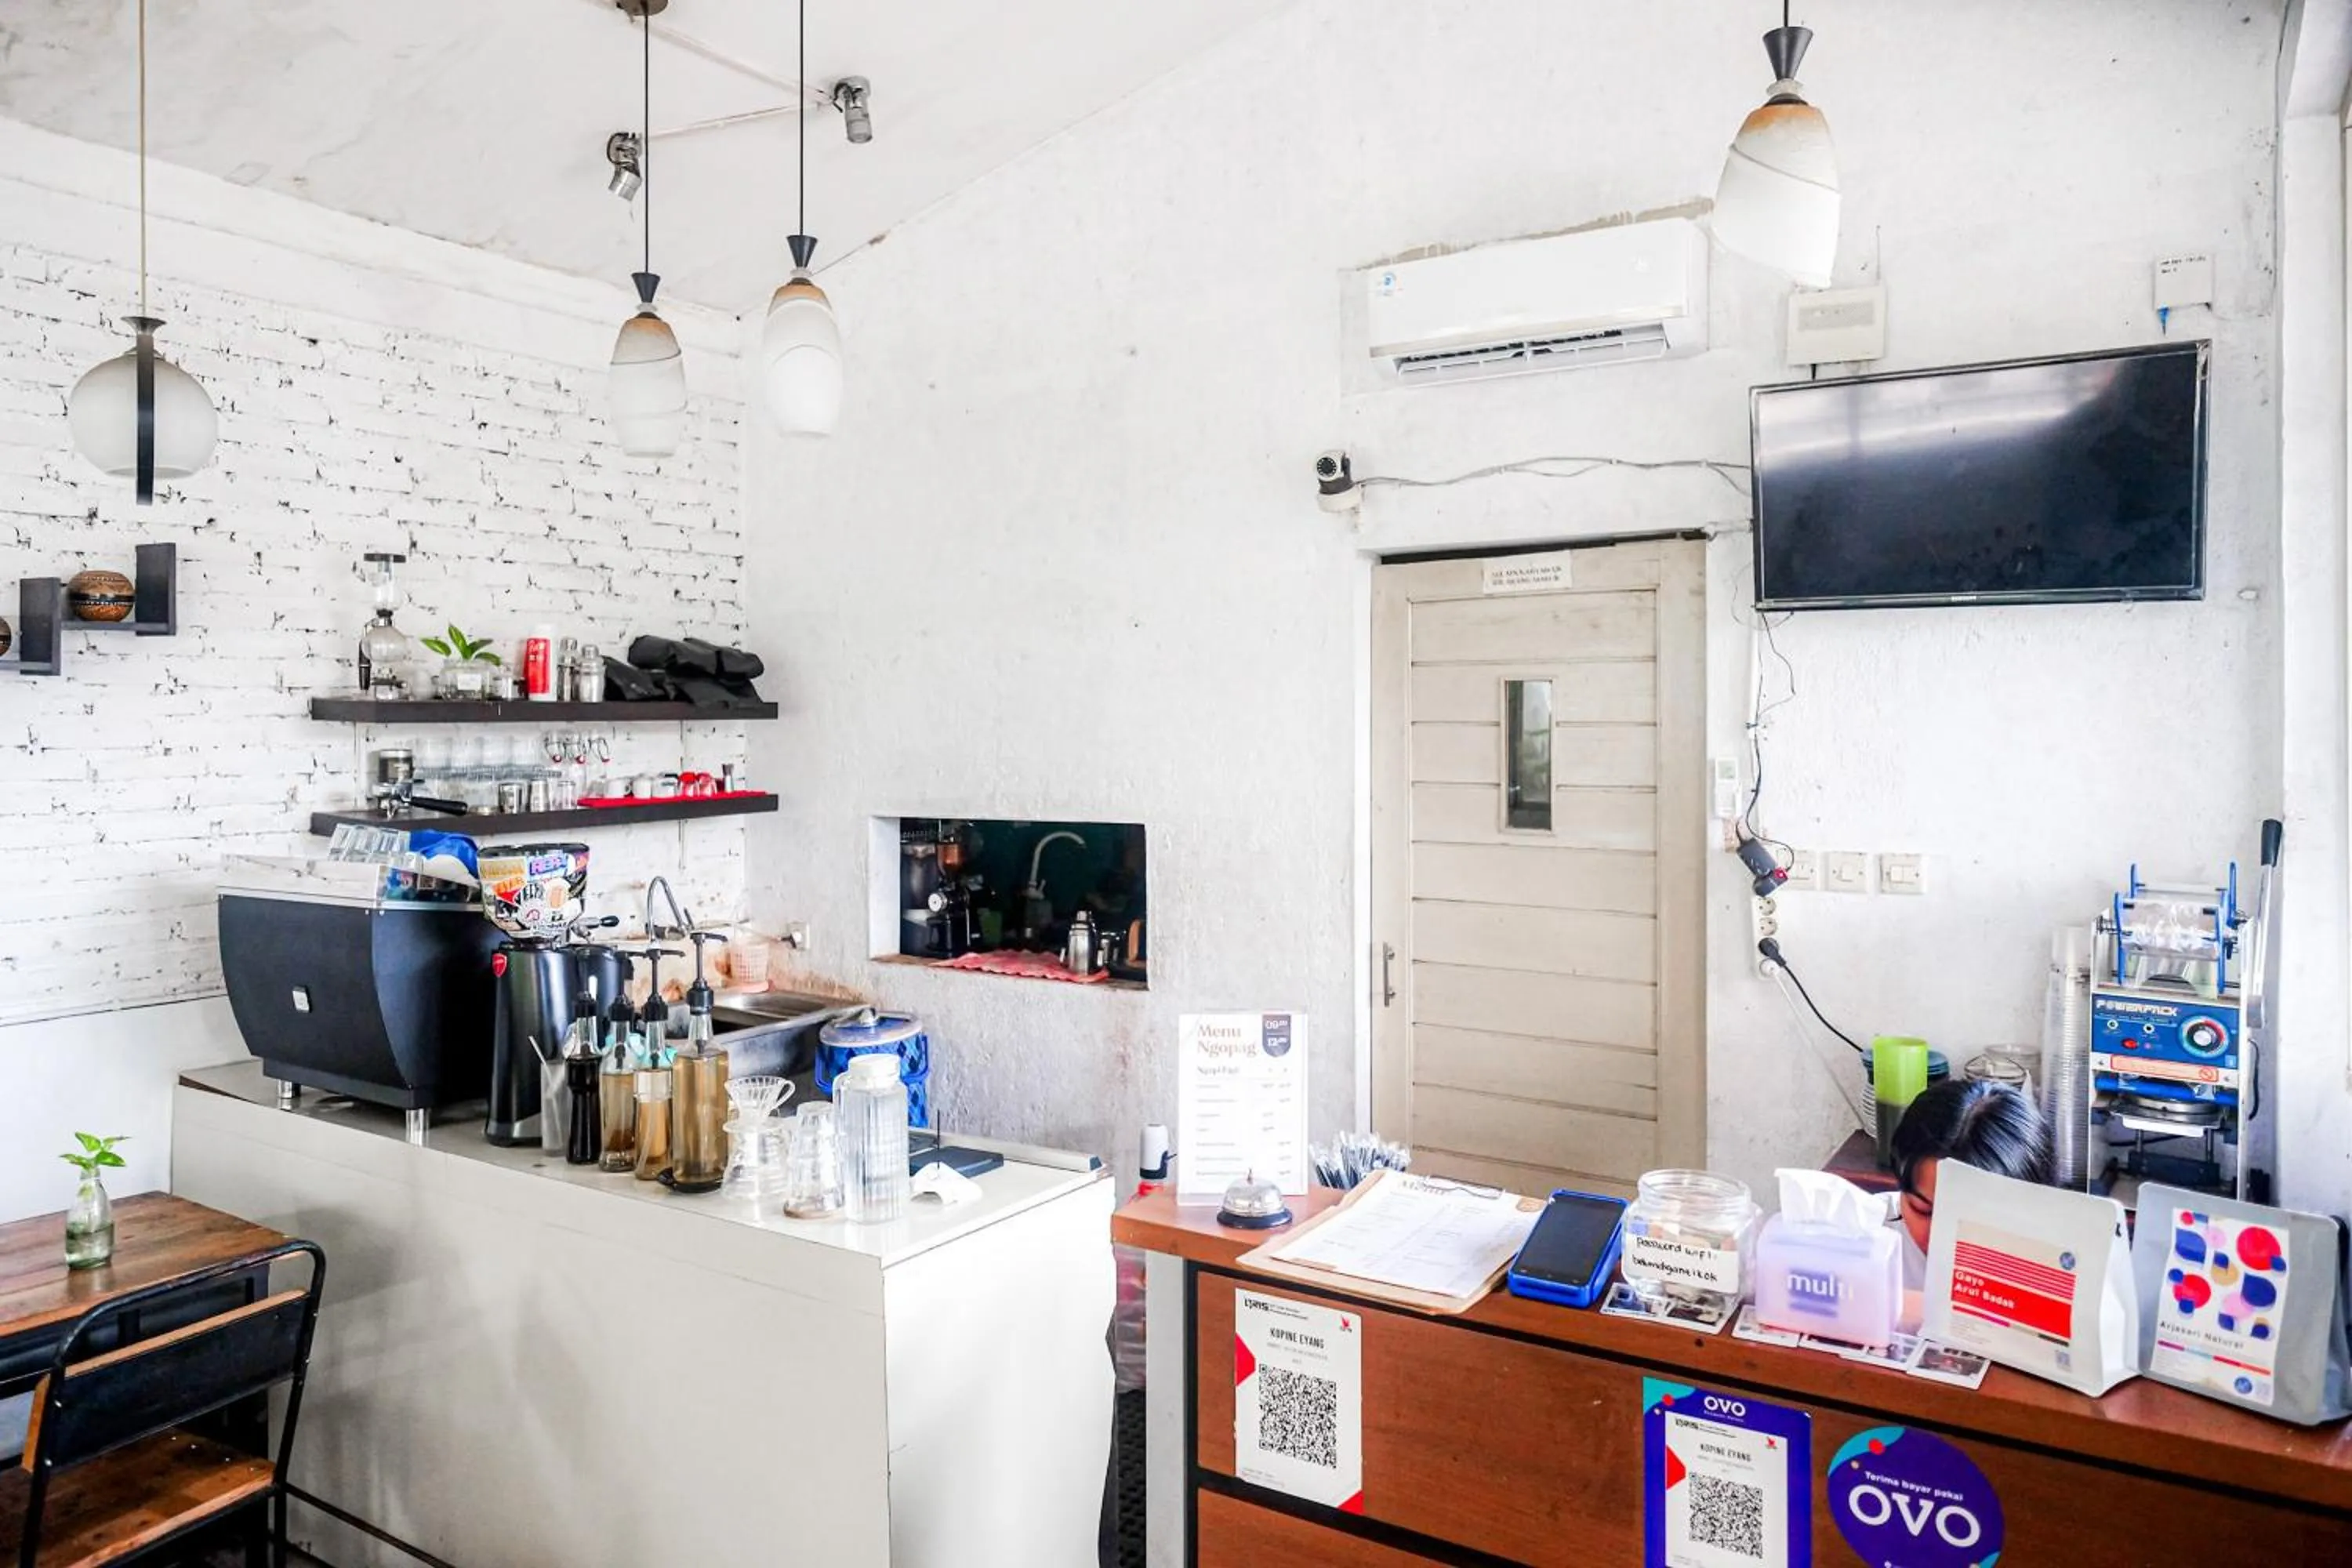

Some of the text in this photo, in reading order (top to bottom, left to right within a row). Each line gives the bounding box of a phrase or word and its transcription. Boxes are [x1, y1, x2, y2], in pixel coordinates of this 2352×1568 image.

[1197, 1024, 1242, 1038] Menu
[1955, 1271, 1985, 1287] Gayo
[1954, 1283, 1980, 1297] Arul
[1270, 1327, 1325, 1349] KOPINE EYANG
[2205, 1333, 2245, 1348] Natural
[1704, 1396, 1746, 1417] OVO
[1864, 1471, 1964, 1501] Terima bayar pakai
[1849, 1484, 1981, 1548] OVO
